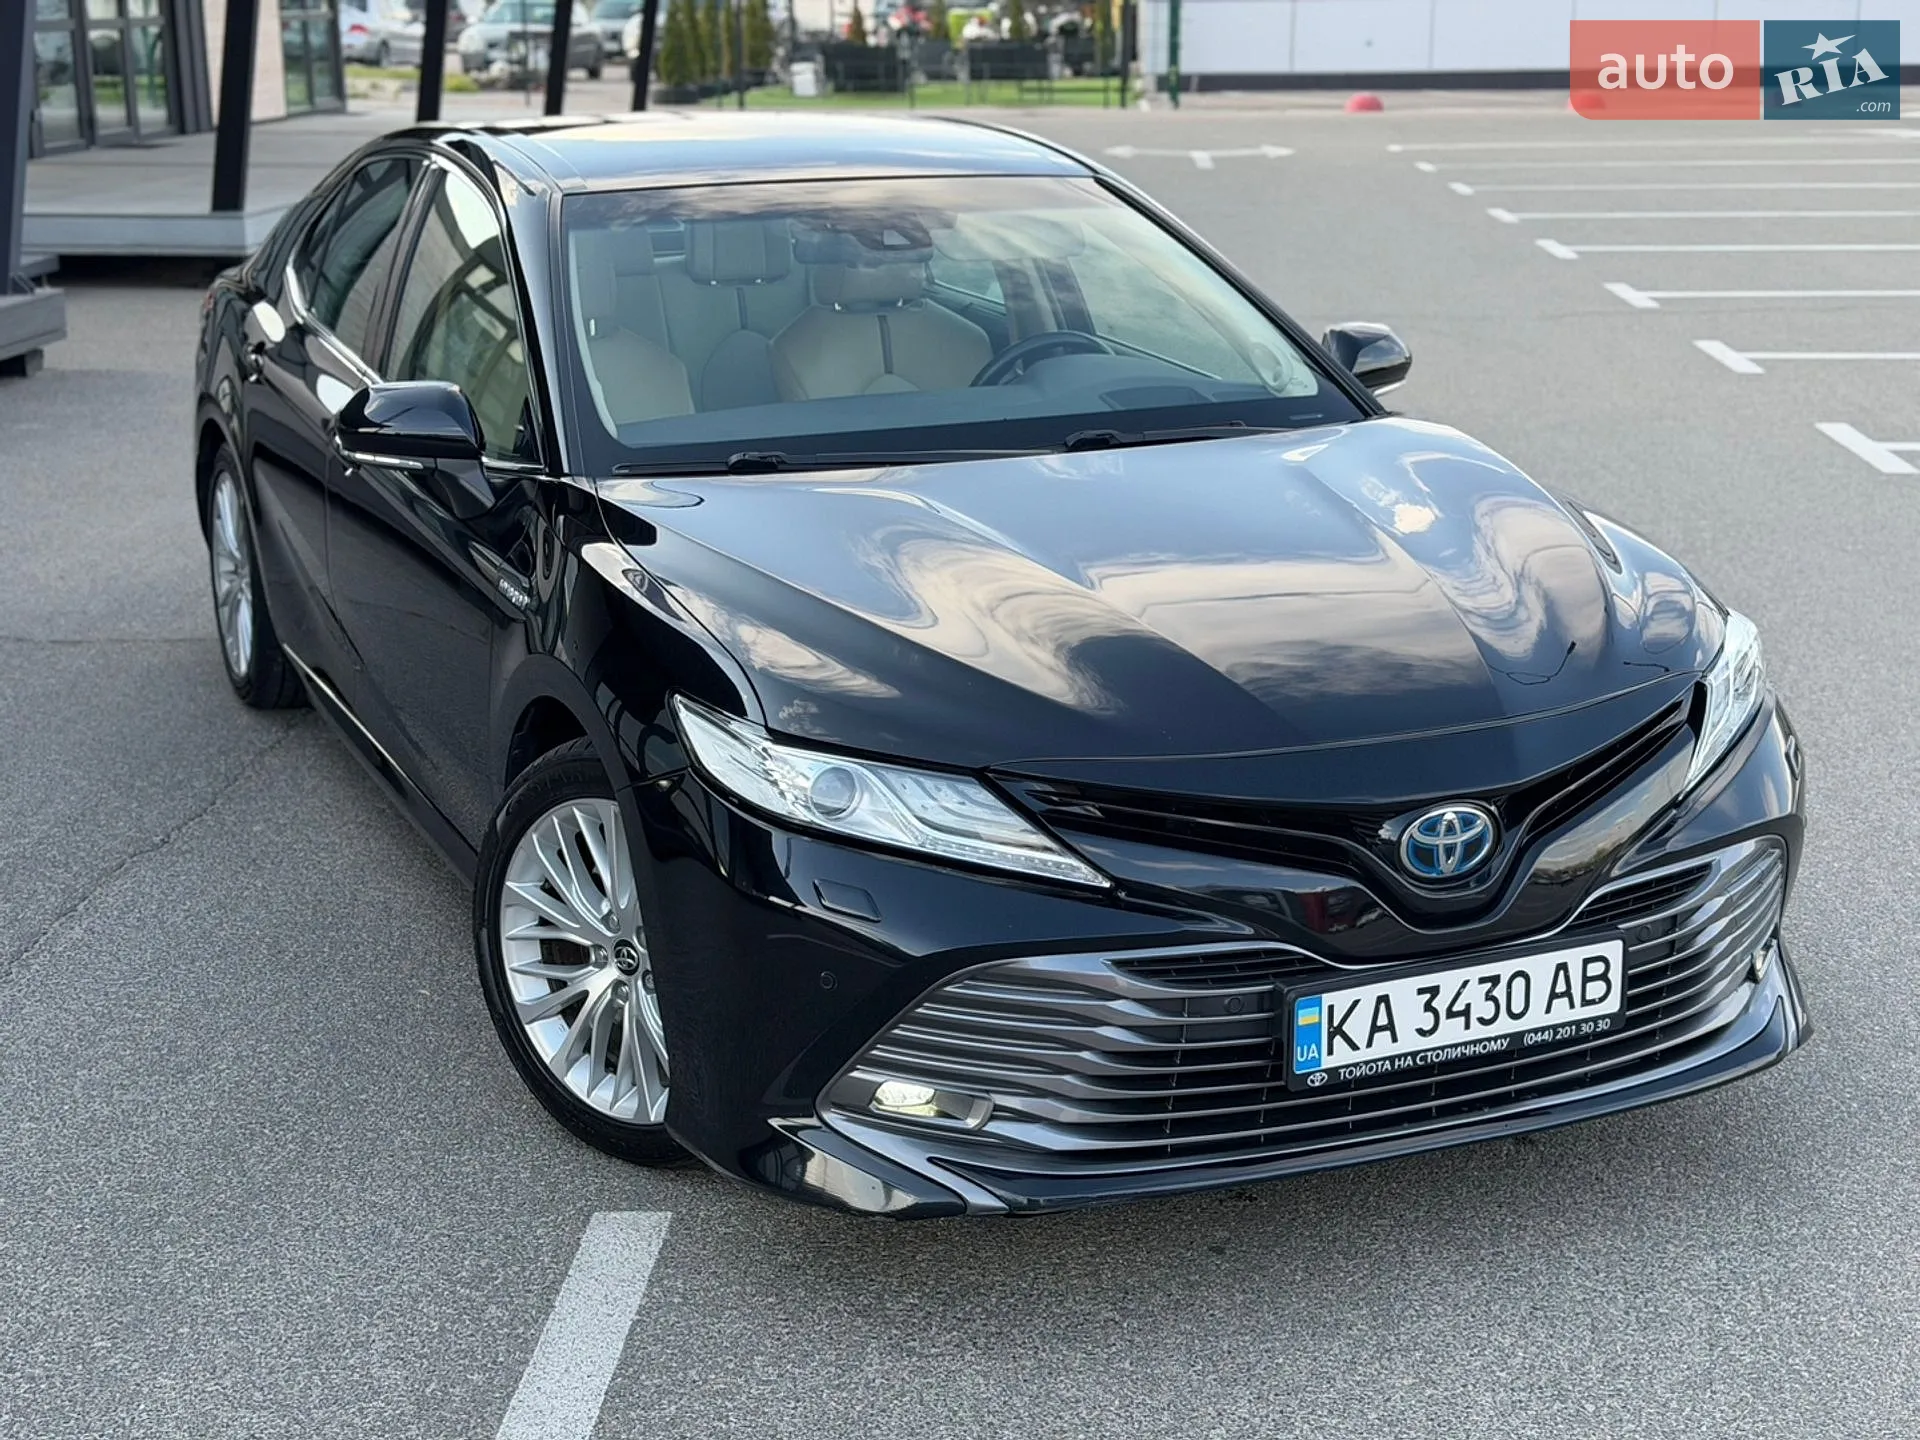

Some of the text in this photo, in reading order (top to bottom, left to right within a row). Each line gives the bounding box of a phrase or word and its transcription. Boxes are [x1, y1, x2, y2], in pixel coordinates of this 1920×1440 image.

[1326, 954, 1613, 1057] KA 3430 AB
[1297, 1043, 1319, 1062] UA
[1338, 1018, 1611, 1081] ТОЙОТА НА СТОЛИЧНОМУ (044) 201 30 30
